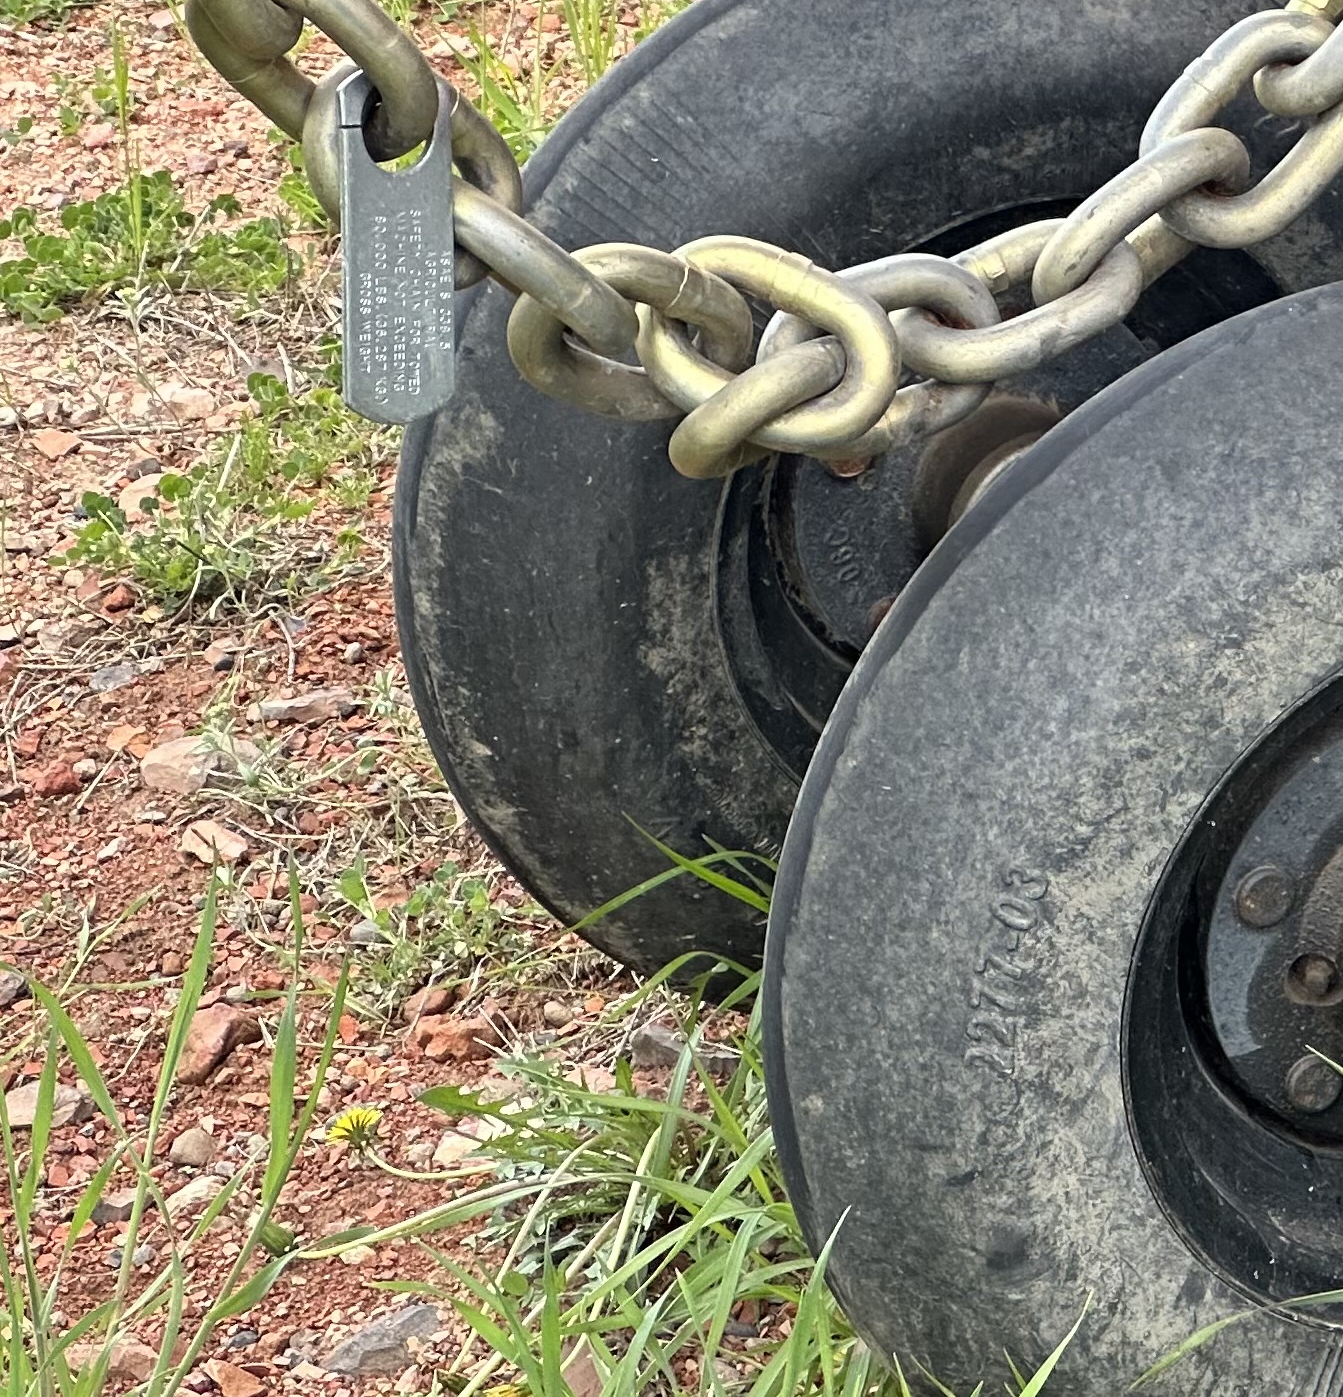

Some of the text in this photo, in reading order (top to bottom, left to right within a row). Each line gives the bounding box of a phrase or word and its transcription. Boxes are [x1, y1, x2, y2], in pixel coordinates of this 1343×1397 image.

[358, 272, 371, 374] GROSS WEIGHT
[393, 316, 406, 392] EXCEEDING
[409, 319, 421, 345] FOR
